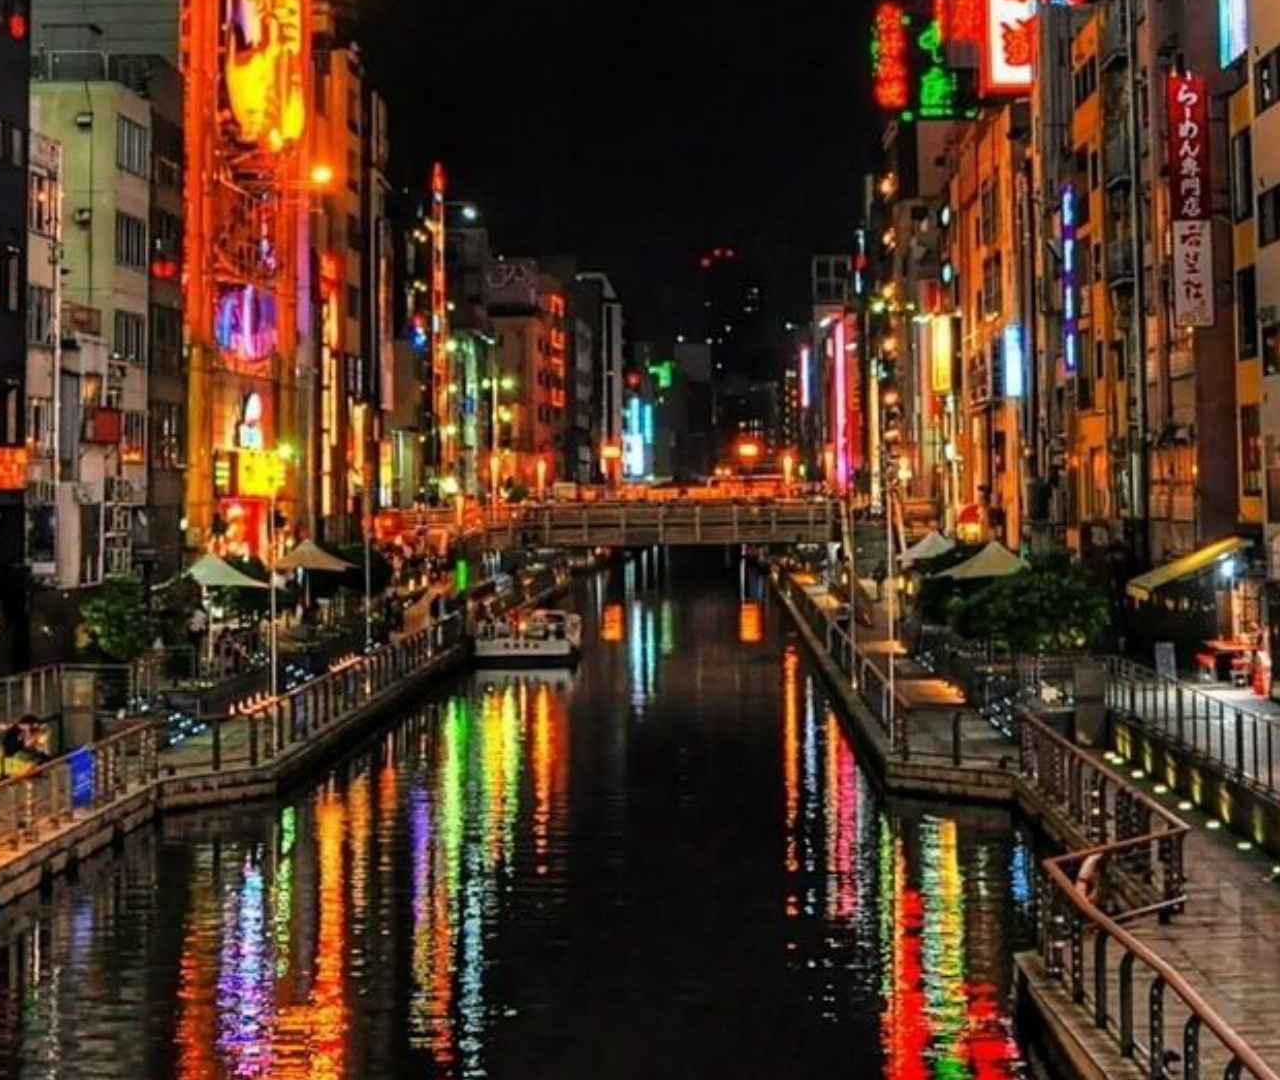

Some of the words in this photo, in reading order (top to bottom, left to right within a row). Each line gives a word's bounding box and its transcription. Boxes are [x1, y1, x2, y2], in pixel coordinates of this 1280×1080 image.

[1177, 84, 1203, 217] らーめん専門店
